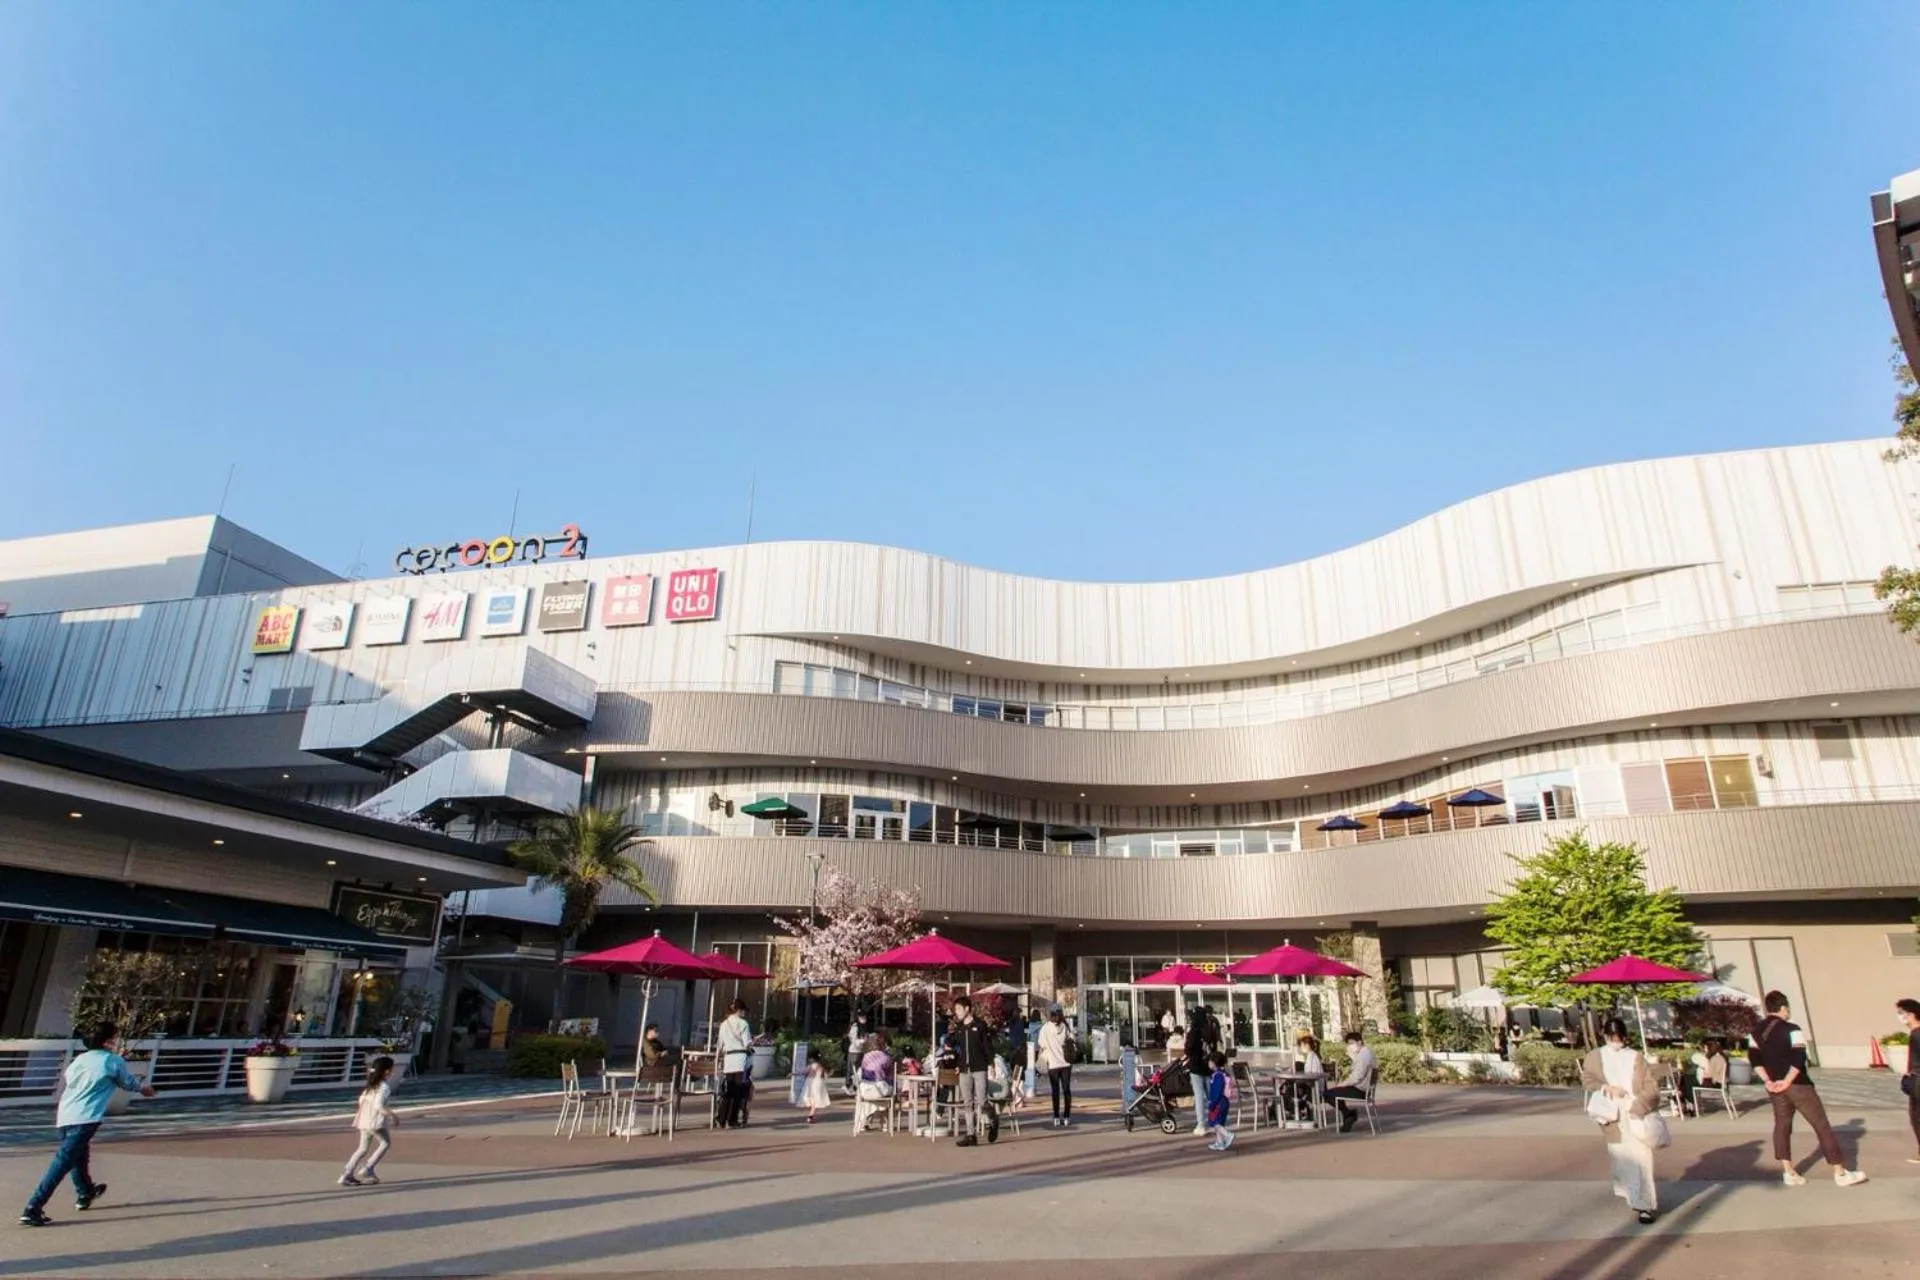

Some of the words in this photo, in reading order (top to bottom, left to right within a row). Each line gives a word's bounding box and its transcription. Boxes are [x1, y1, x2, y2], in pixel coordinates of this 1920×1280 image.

[395, 535, 545, 573] cocoon
[559, 523, 581, 558] 2
[673, 574, 709, 593] UNI
[671, 594, 710, 616] QLO
[258, 613, 292, 632] ABC
[255, 631, 290, 646] MART
